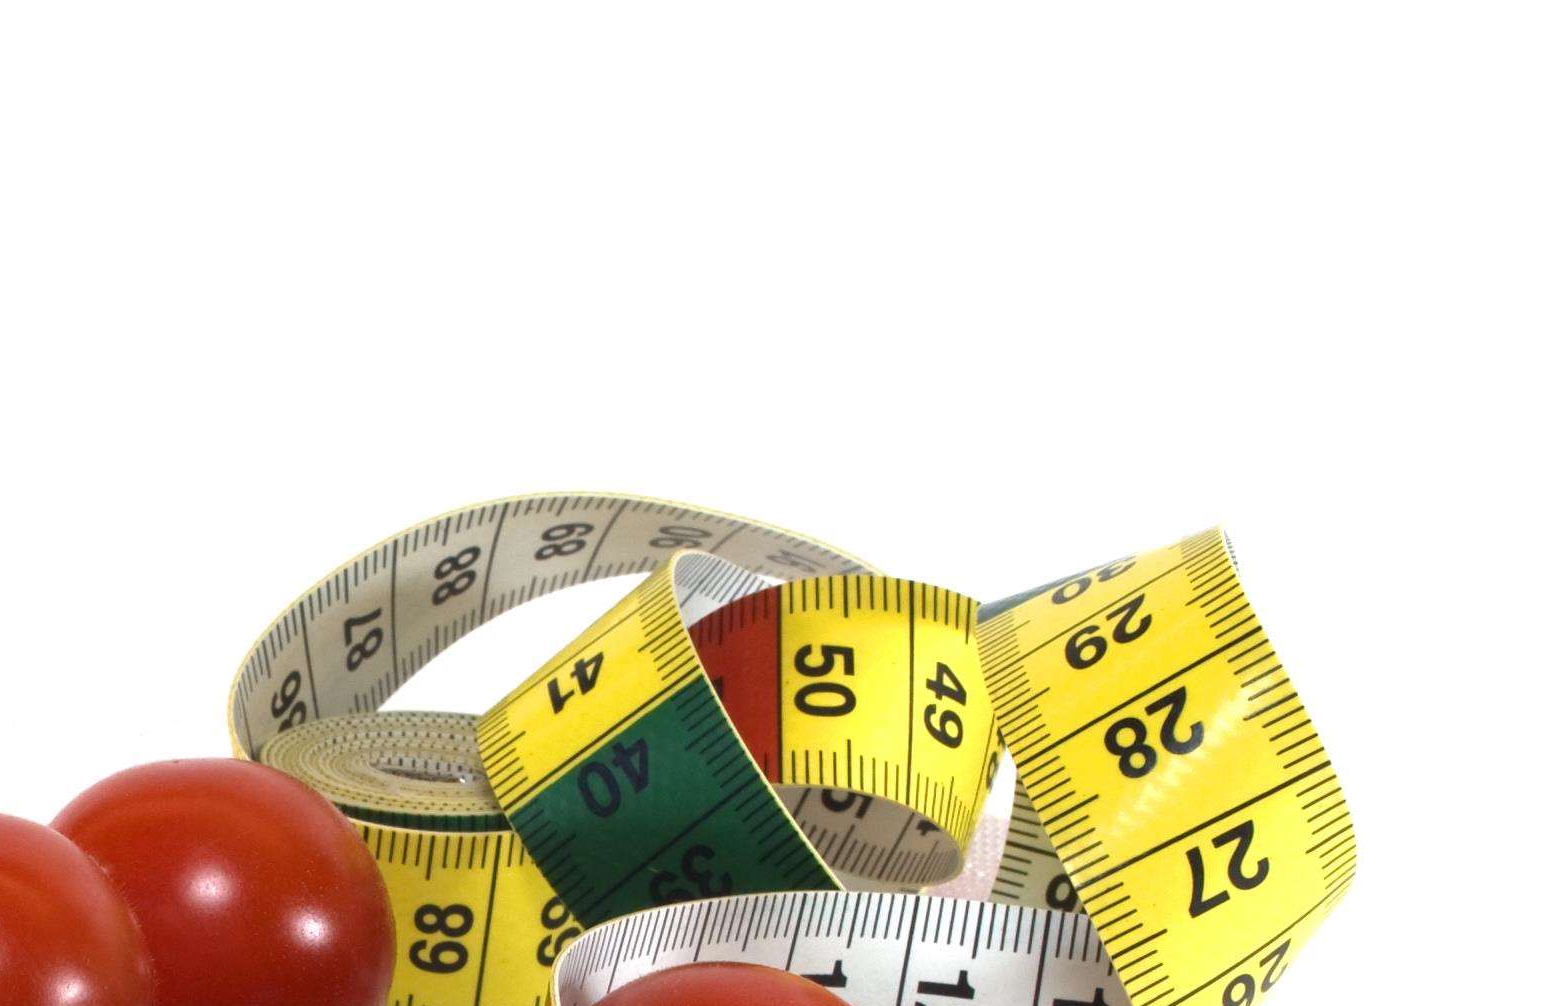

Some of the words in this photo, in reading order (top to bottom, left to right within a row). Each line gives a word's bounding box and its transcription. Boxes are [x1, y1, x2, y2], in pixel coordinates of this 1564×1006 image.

[534, 522, 595, 561] 89
[649, 516, 713, 549] 90
[431, 545, 482, 606] 88
[1050, 560, 1138, 605] 30
[343, 607, 385, 672] 87
[1064, 592, 1153, 671] 29
[546, 651, 605, 715] 41
[793, 644, 857, 718] 50
[923, 661, 968, 749] 49
[1103, 685, 1206, 780] 28
[576, 737, 650, 819] 40
[1184, 818, 1271, 920] 27
[408, 903, 475, 974] 68
